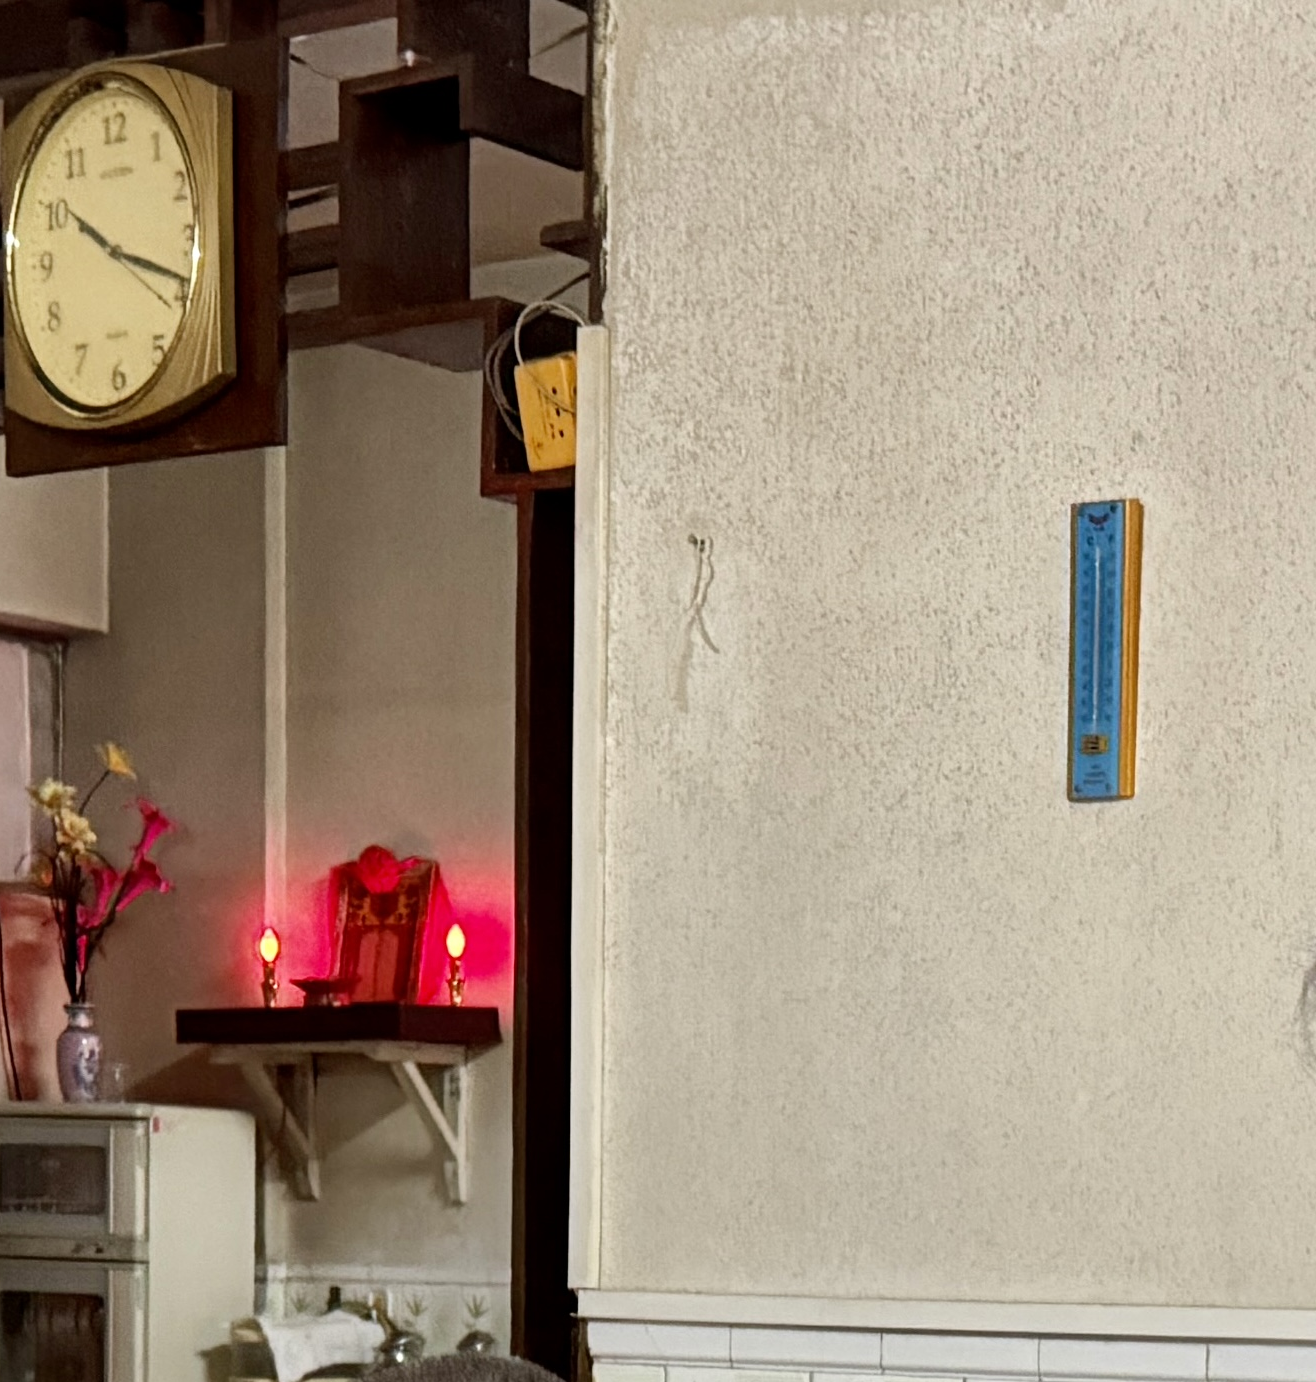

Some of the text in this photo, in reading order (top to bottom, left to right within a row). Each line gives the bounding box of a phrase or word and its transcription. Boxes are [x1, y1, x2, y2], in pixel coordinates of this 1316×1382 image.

[102, 112, 127, 145] 12
[151, 131, 163, 163] 1
[65, 147, 87, 180] 11
[173, 170, 189, 201] 2
[44, 200, 69, 231] 10
[39, 252, 54, 281] 9
[47, 302, 62, 332] 8
[73, 344, 89, 376] 7
[152, 335, 166, 367] 5
[111, 360, 127, 391] 6
